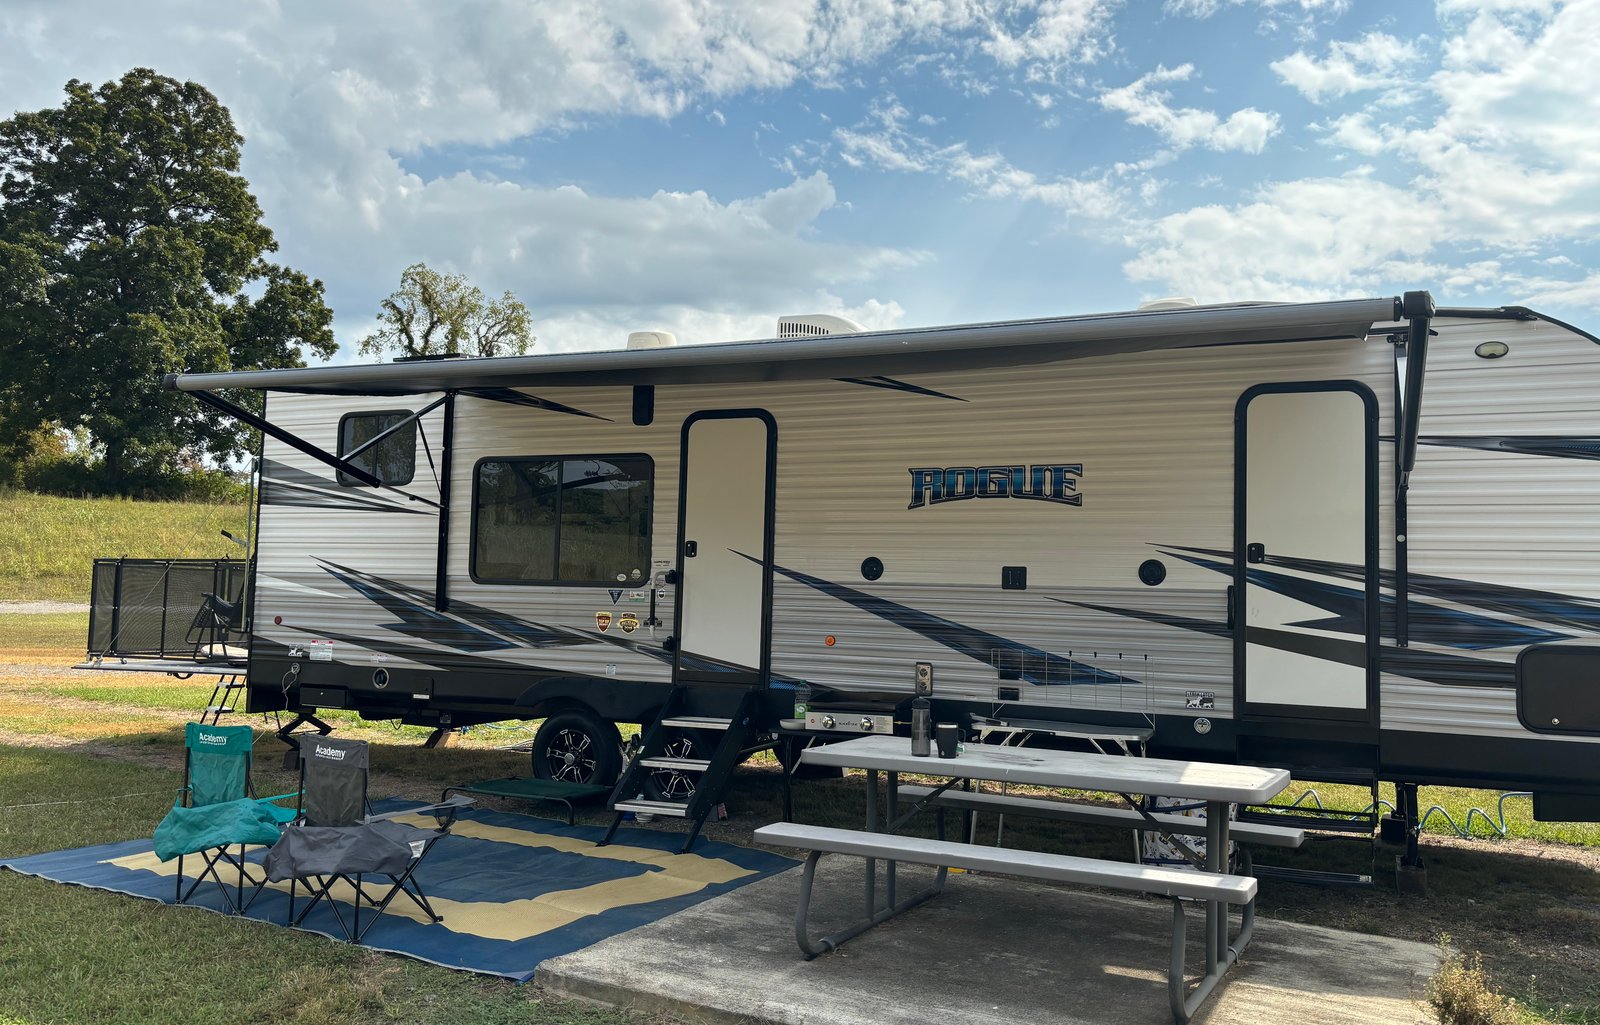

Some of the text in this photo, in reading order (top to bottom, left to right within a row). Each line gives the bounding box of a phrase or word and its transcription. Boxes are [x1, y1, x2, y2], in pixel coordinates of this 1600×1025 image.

[908, 463, 1083, 510] ROGUE
[199, 732, 227, 744] Academy
[315, 744, 346, 760] Academy
